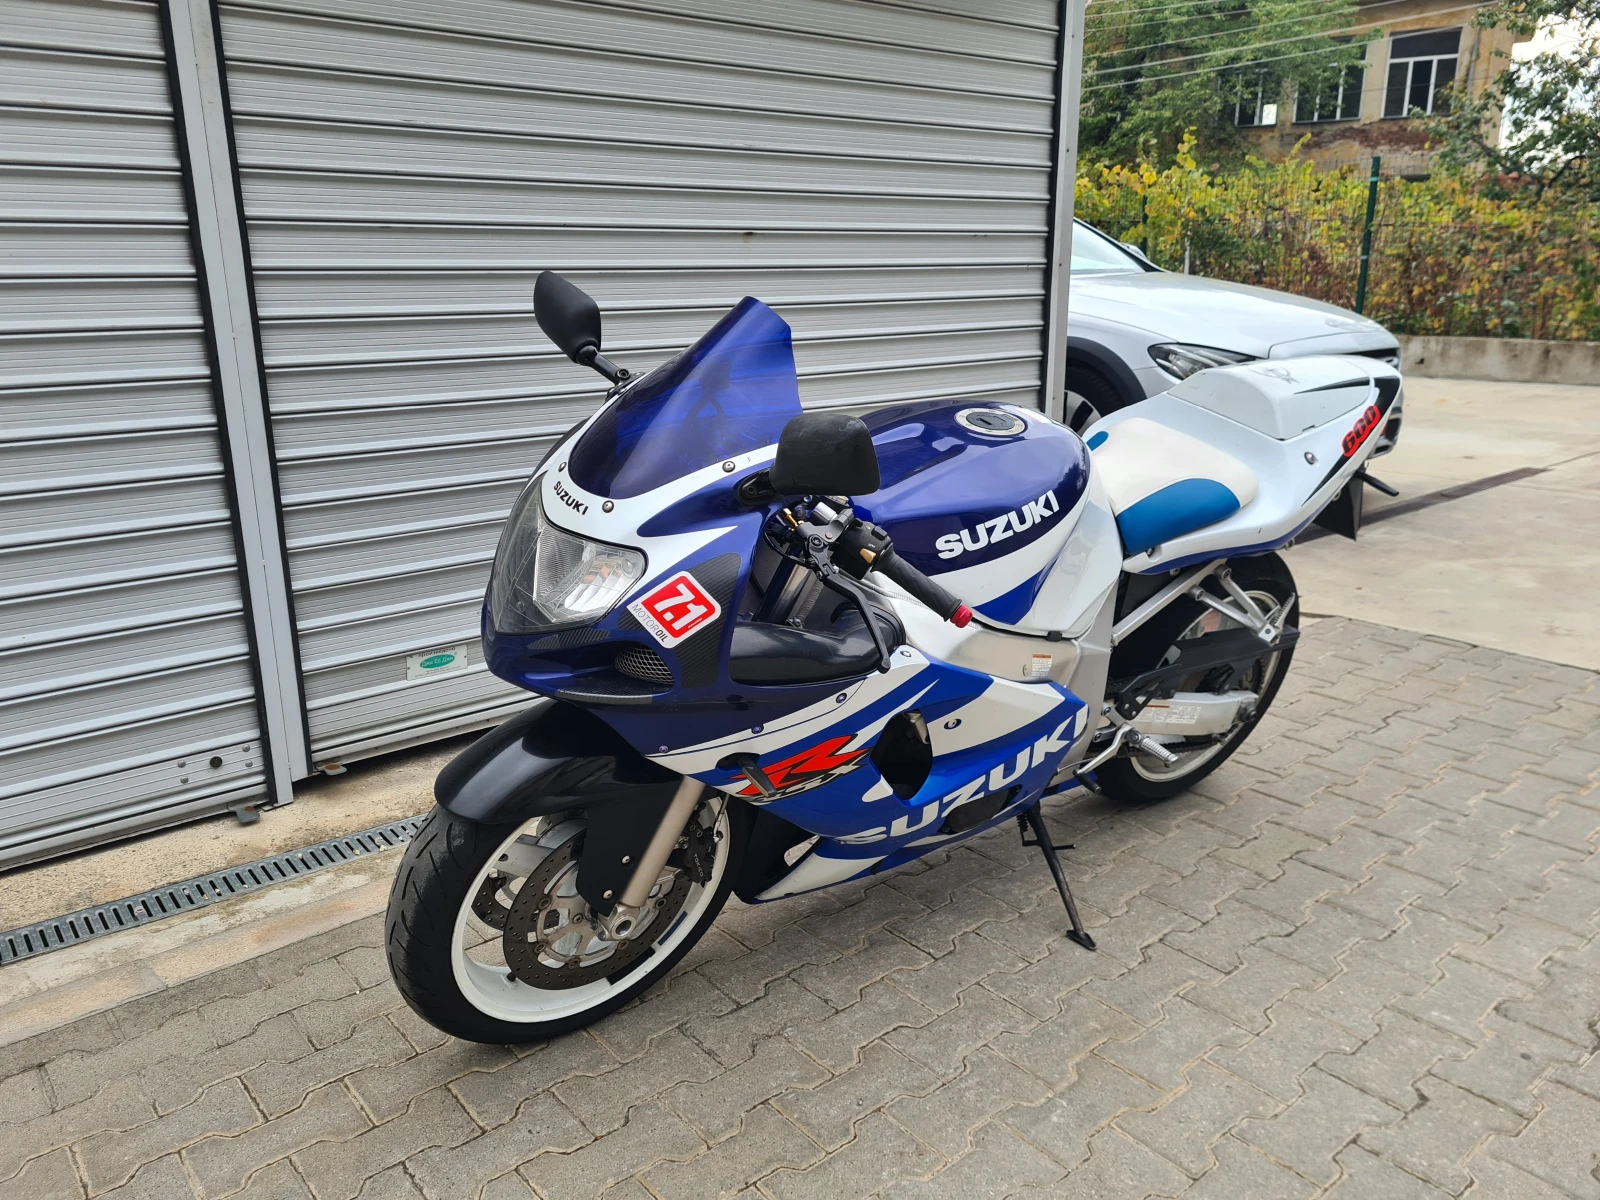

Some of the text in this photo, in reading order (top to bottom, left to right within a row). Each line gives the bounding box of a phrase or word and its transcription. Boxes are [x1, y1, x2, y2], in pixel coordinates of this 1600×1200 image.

[1342, 405, 1381, 458] 600
[553, 480, 589, 516] SUZUKI
[935, 489, 1060, 560] SUZUKI
[833, 703, 1089, 845] SUZUKI
